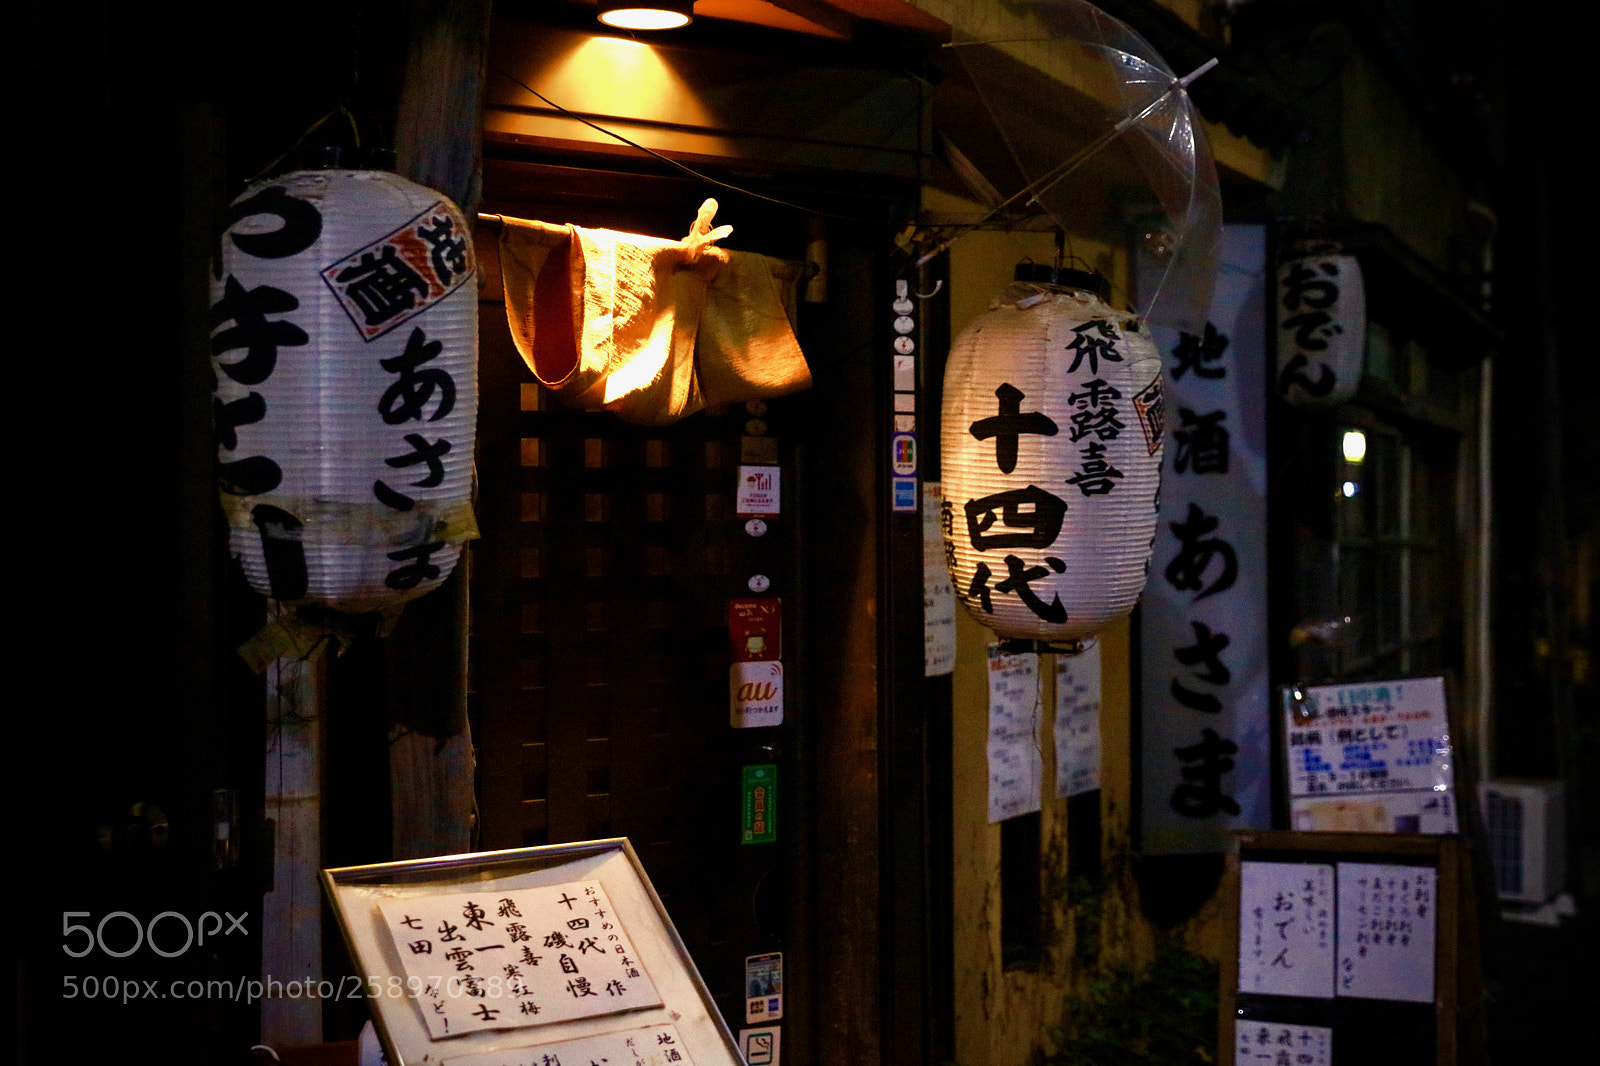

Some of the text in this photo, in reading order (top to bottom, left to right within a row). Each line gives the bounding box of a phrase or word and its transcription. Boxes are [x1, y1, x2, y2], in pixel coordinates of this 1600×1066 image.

[1281, 262, 1343, 396] おでん
[1065, 319, 1126, 497] 飛露喜
[374, 327, 456, 589] あさま
[964, 382, 1068, 624] 十四代
[737, 682, 777, 701] au
[399, 914, 432, 955] 七田
[462, 900, 505, 953] 東一
[497, 897, 543, 967] 飛露喜
[557, 892, 606, 955] 十四代
[583, 886, 640, 979] おすすめの日本酒
[1271, 891, 1296, 969] おでん
[437, 919, 501, 1021] 出雲富士
[502, 963, 541, 1016] 寒紅梅
[542, 930, 598, 998] 磯自慢
[605, 979, 627, 997] 作
[657, 1032, 683, 1062] 地酒
